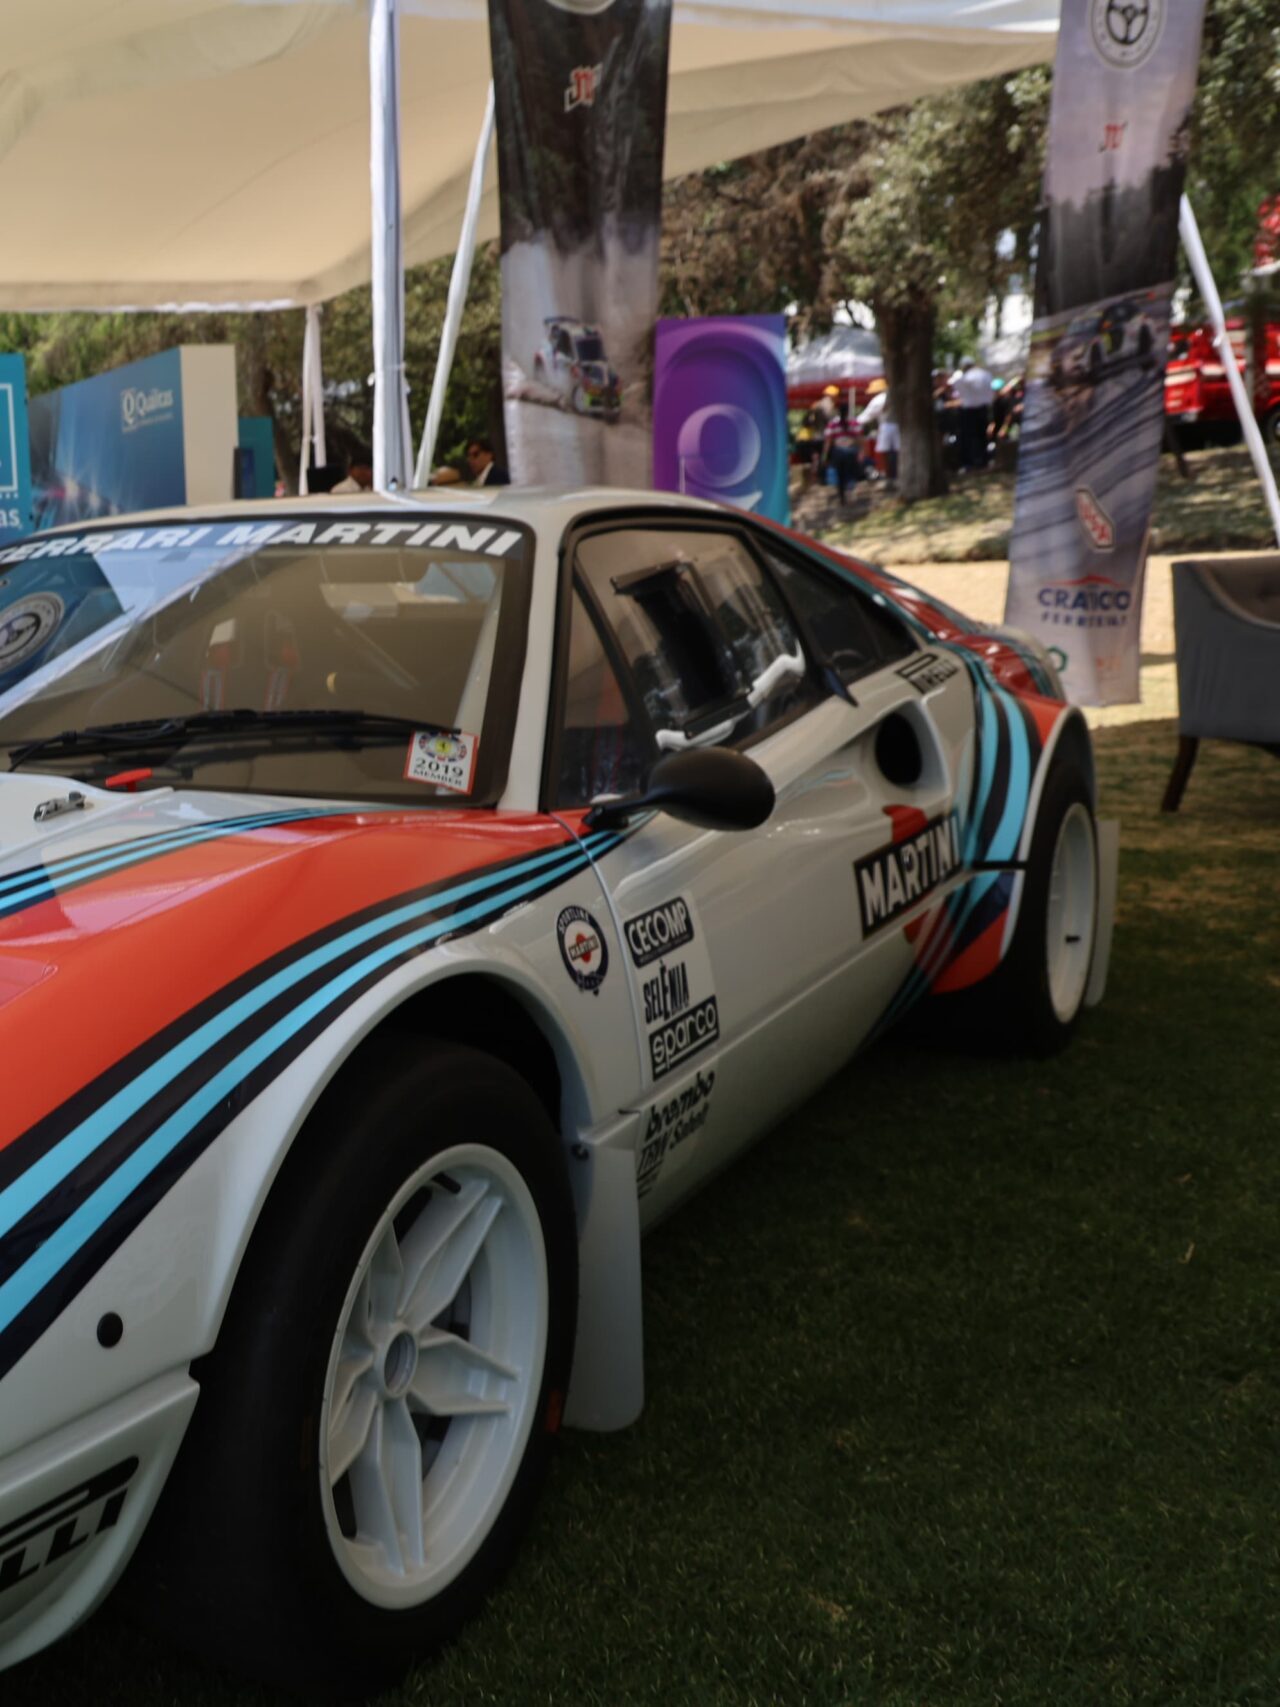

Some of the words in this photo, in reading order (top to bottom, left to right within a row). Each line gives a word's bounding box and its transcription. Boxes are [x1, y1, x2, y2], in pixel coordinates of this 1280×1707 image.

[218, 520, 523, 557] MARTINI
[861, 814, 960, 926] MARTINI
[628, 901, 688, 956] CECOMP
[652, 1001, 717, 1065] sparco
